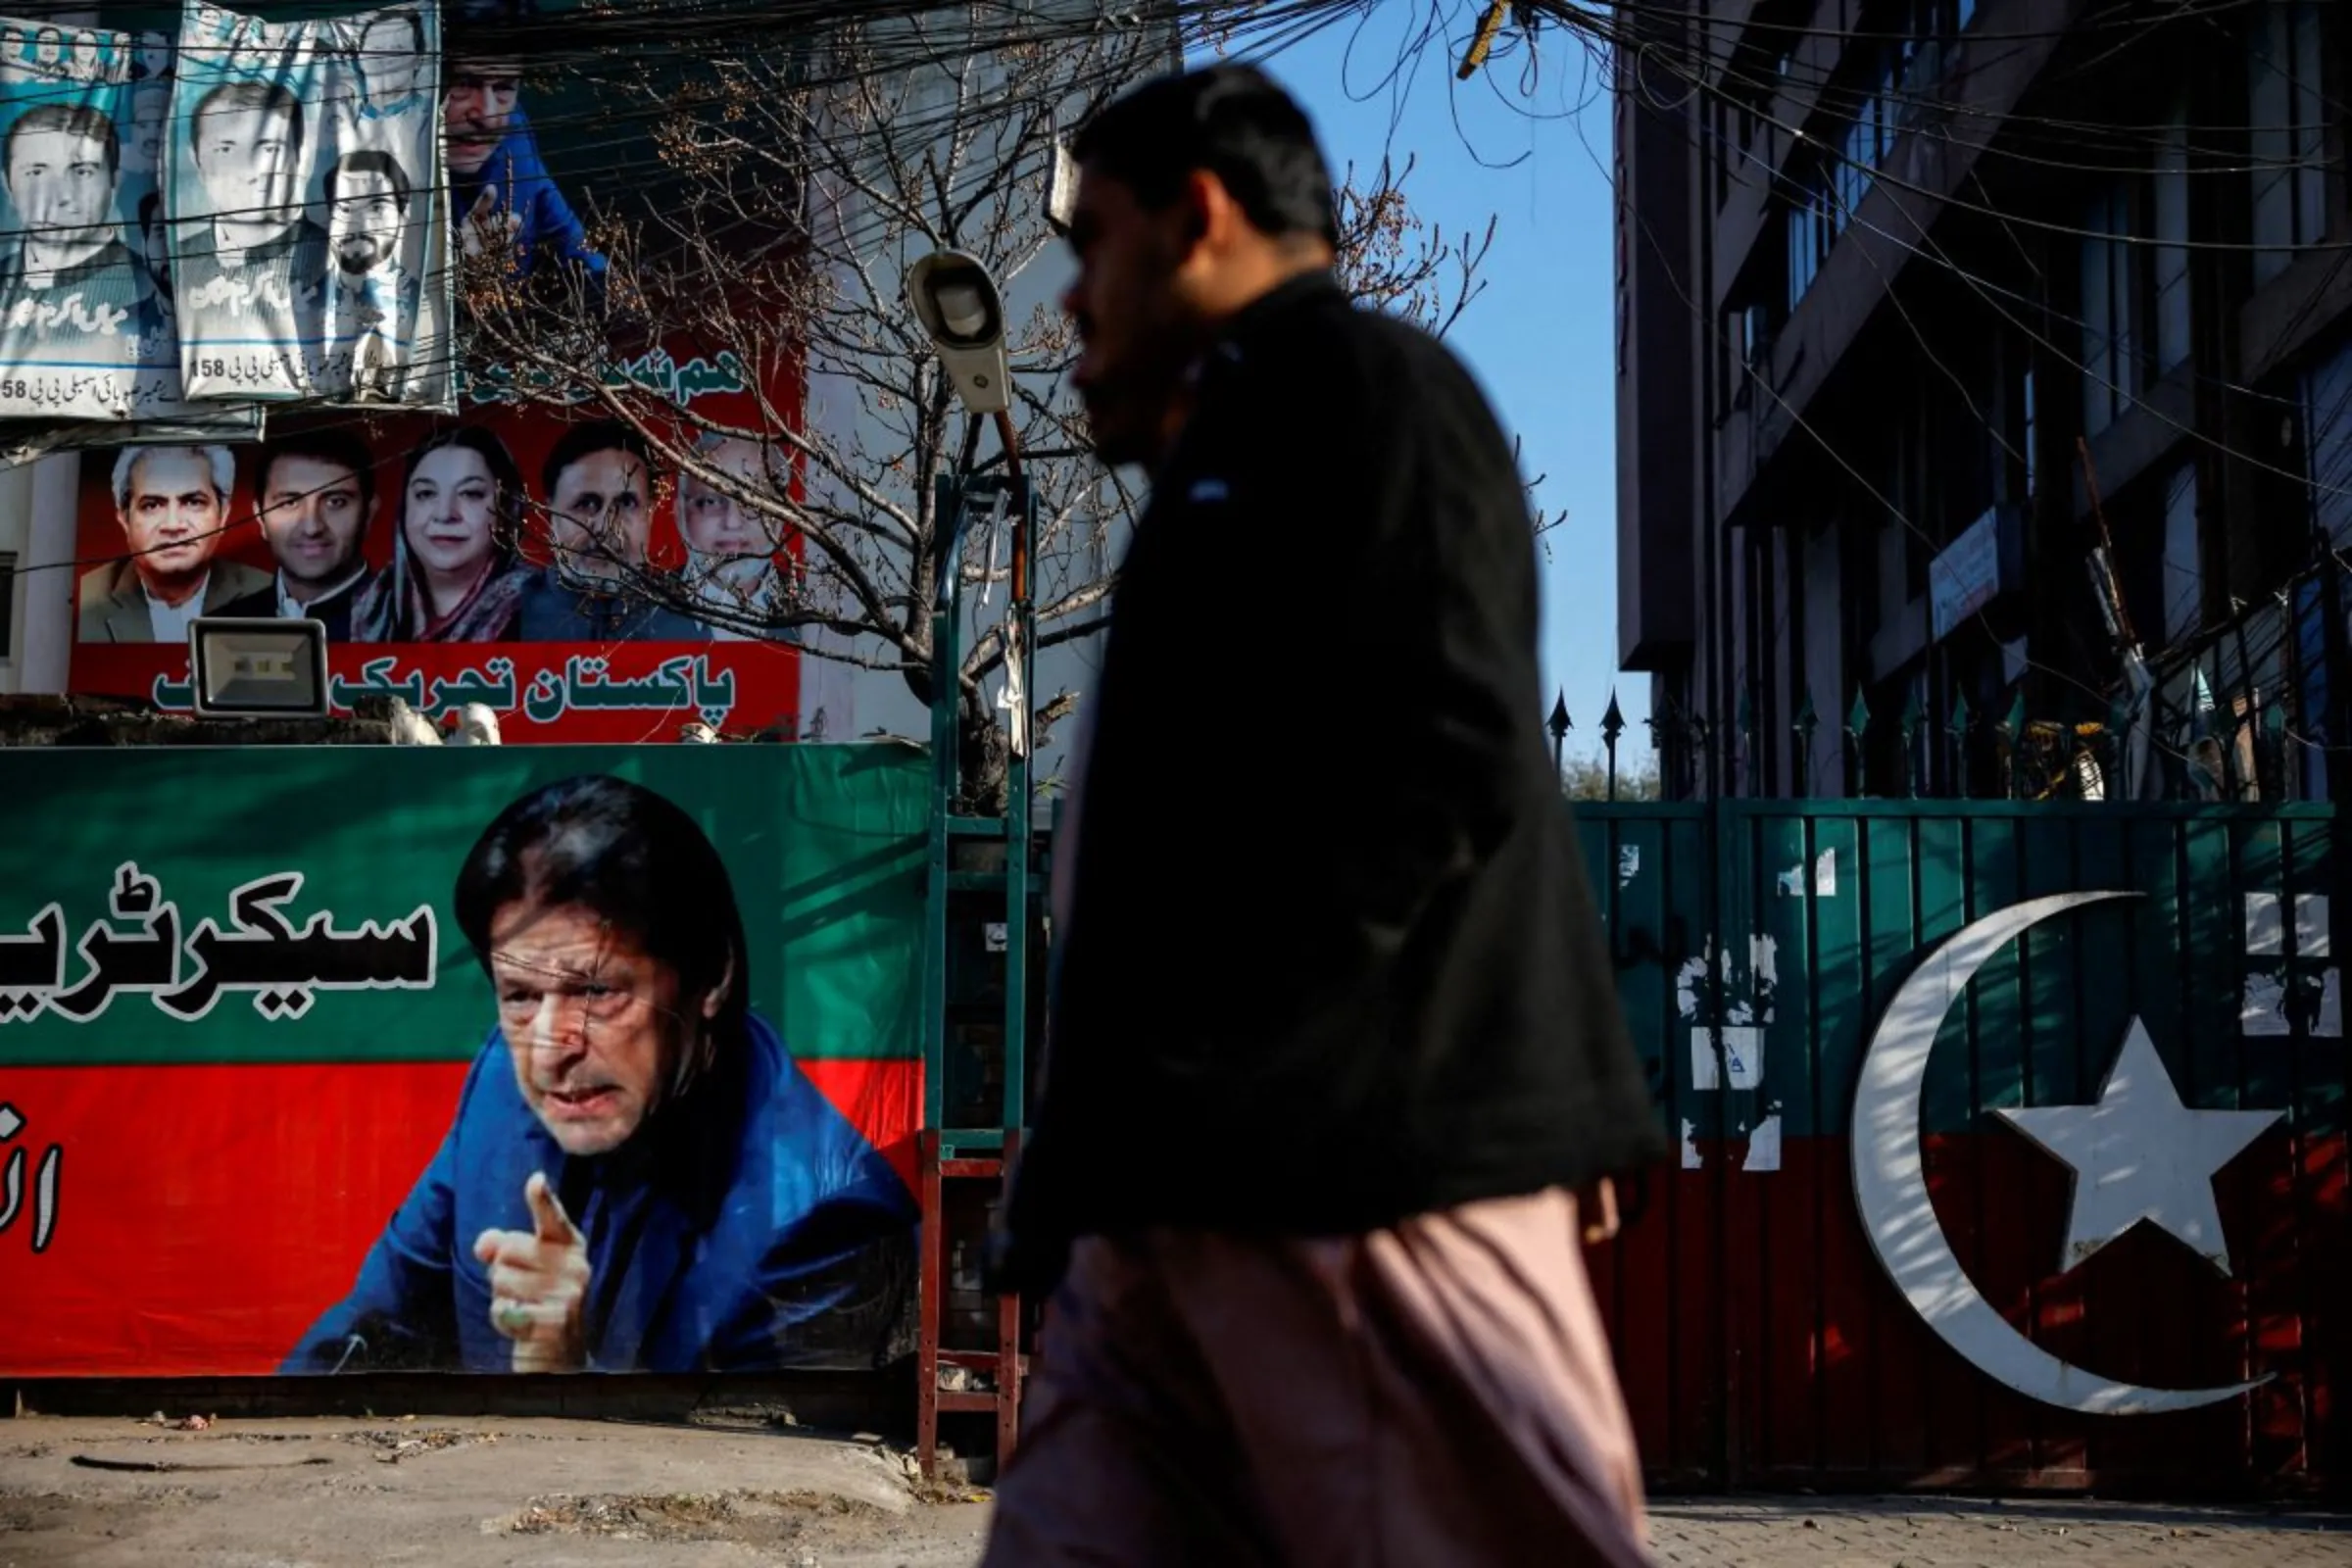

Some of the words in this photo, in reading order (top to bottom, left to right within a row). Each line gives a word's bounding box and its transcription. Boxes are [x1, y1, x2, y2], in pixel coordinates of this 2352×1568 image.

[190, 358, 224, 377] 158
[523, 657, 735, 727] پاکستان
[0, 861, 437, 1021] سیکرٹری
